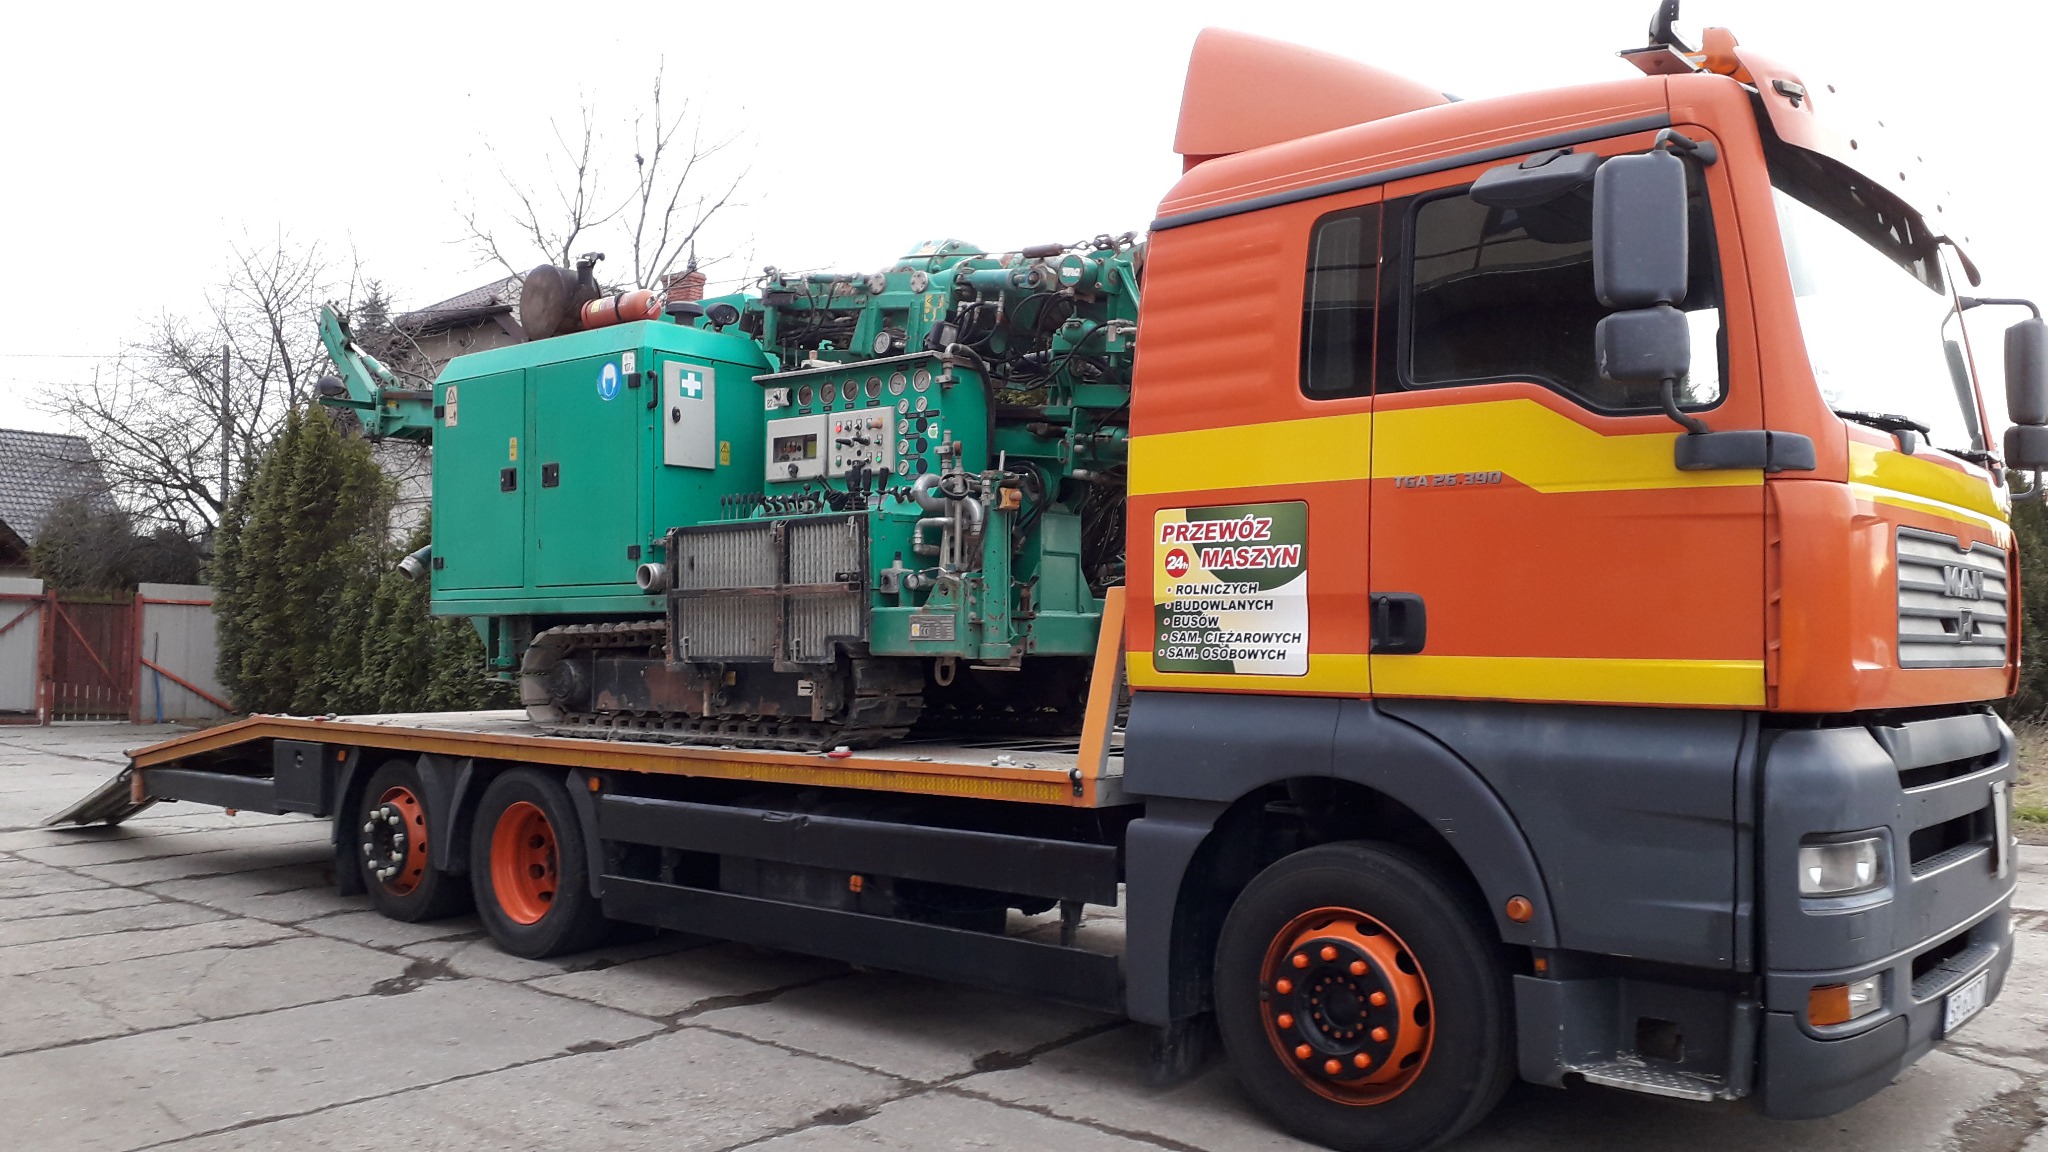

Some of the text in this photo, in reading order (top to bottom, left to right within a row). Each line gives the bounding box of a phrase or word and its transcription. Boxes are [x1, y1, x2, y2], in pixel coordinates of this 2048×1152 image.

[1394, 470, 1502, 489] TGA 26.390
[1161, 516, 1271, 543] PRZEWÓZ
[1166, 555, 1189, 570] 24h
[1201, 546, 1300, 569] MASZYN
[1175, 583, 1258, 595] ROLNICZYCH
[1944, 565, 1984, 600] MAN
[1174, 599, 1274, 611] BUDOWLANYCH
[1173, 613, 1220, 627] BUSÓW
[1170, 630, 1302, 646] SAM. CIĘŻAROWYCH
[1167, 648, 1287, 660] SAM. OSOBOWYCH
